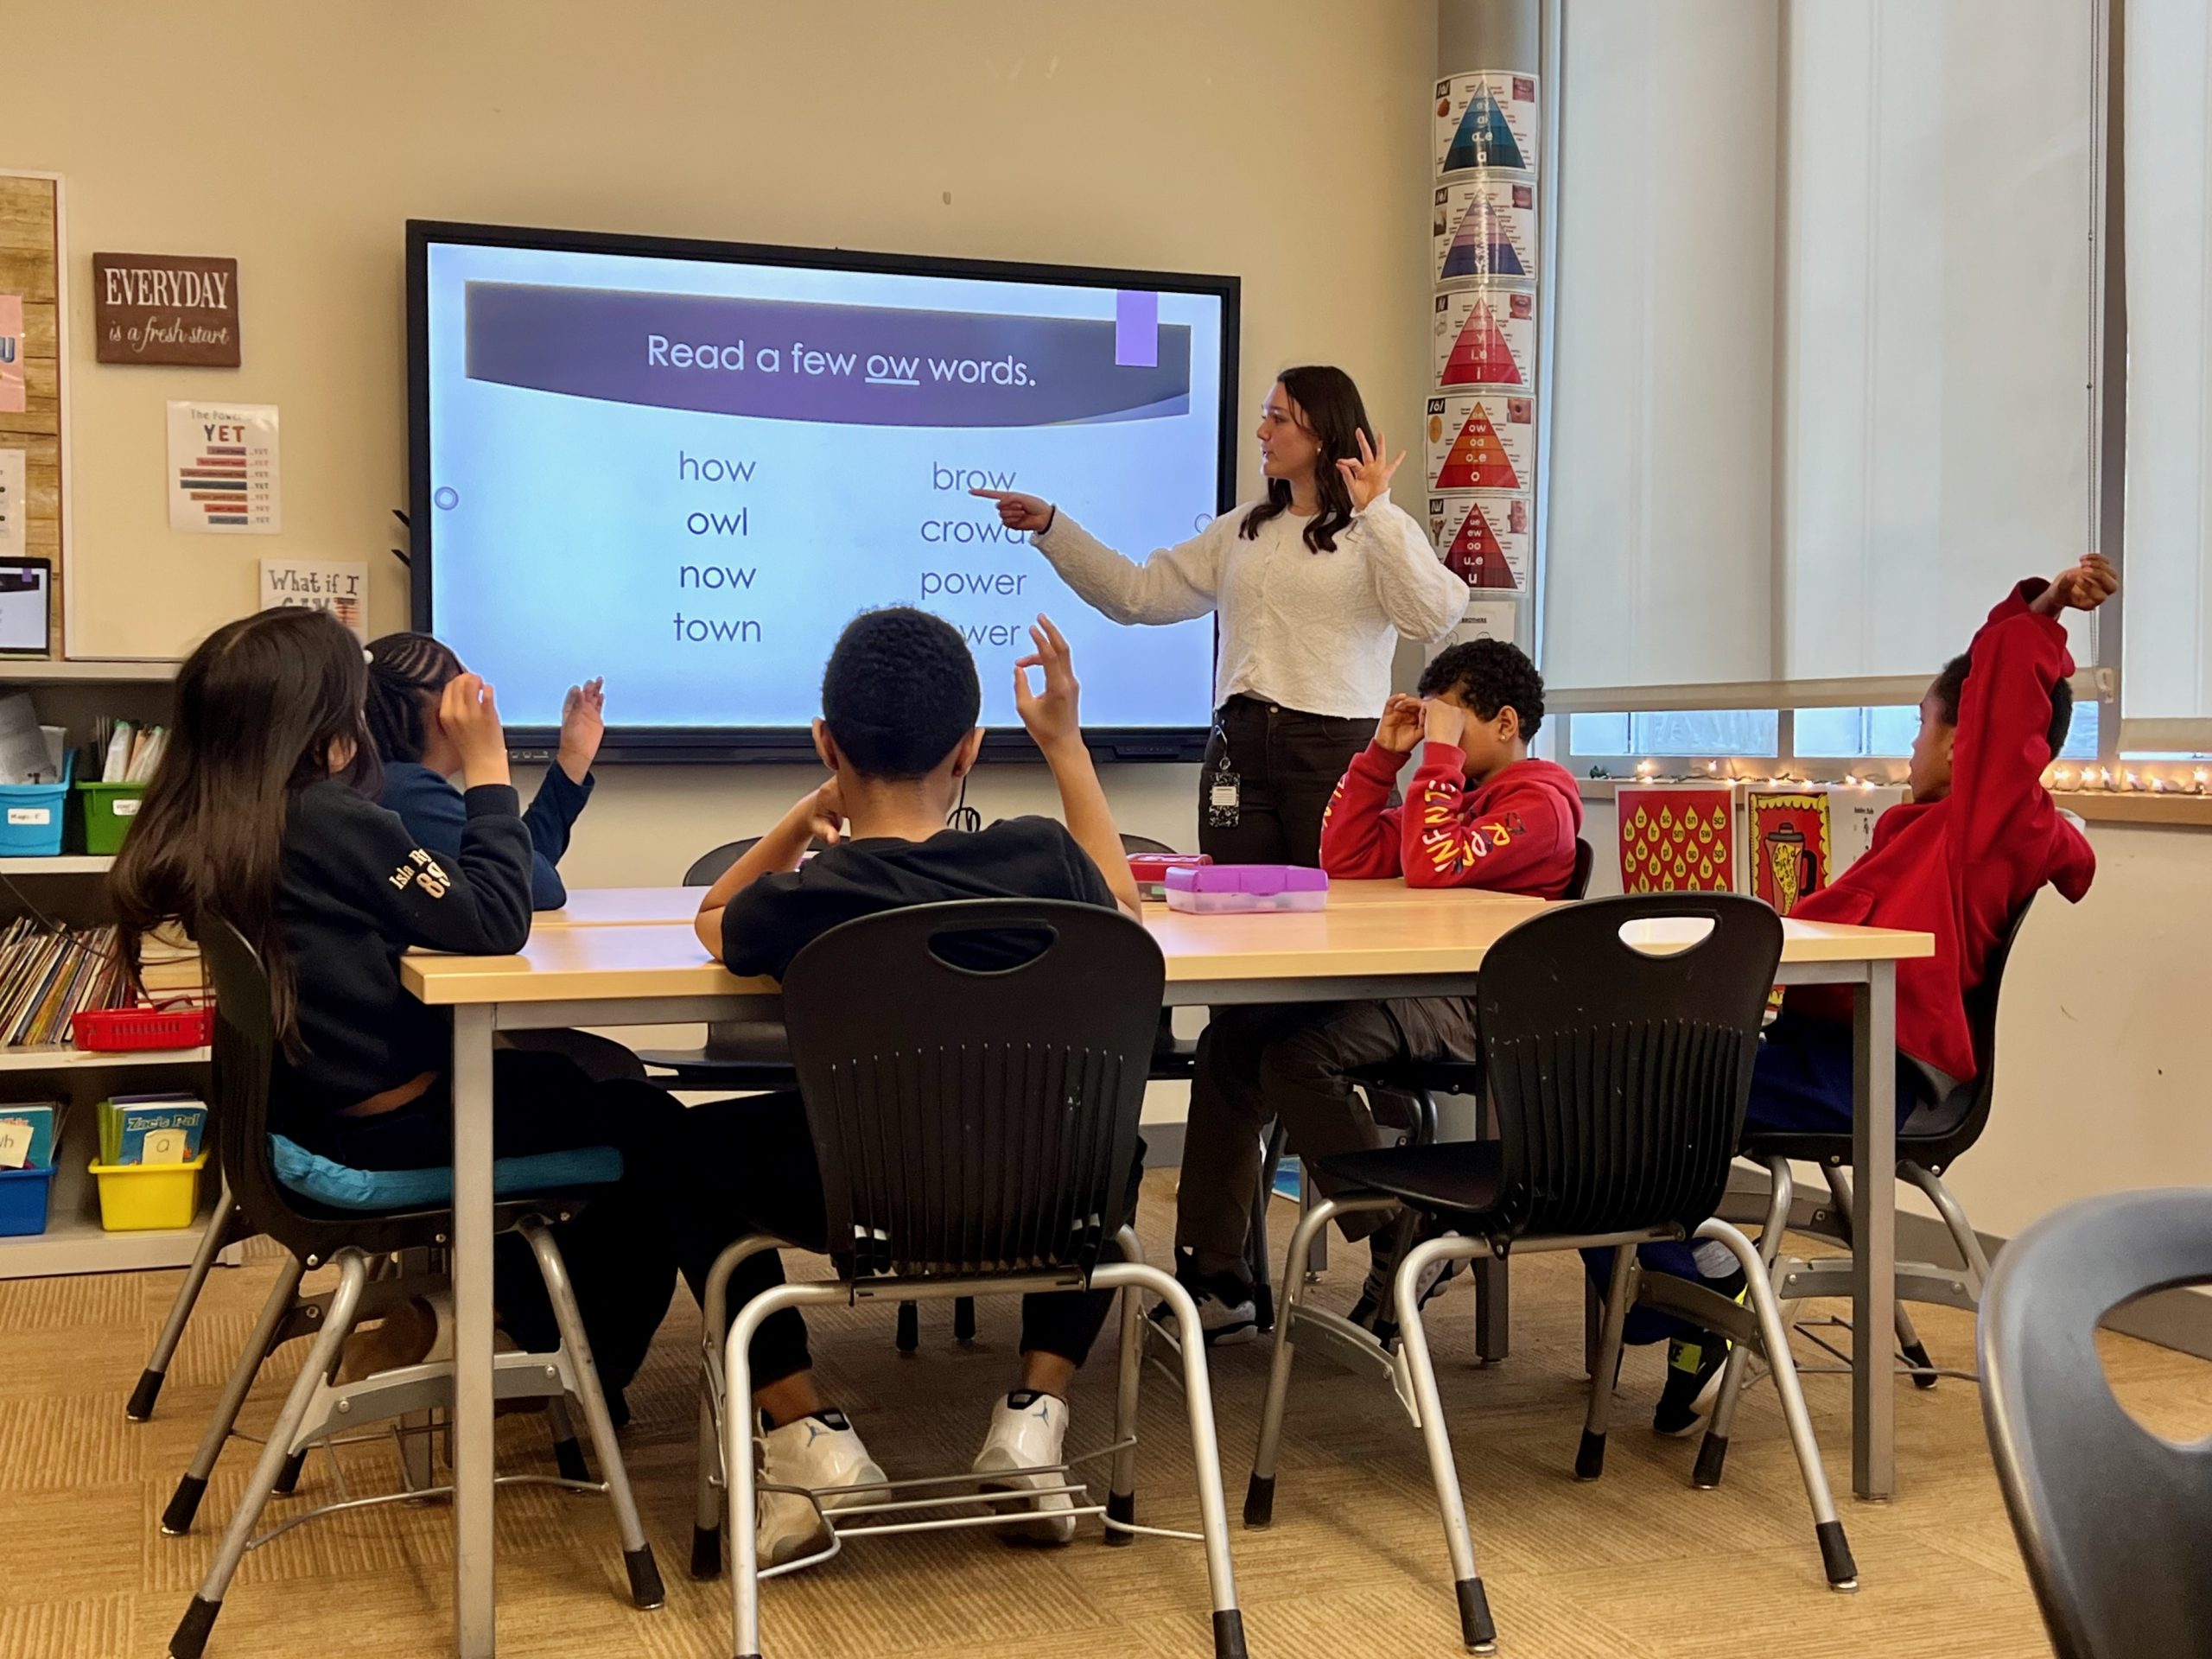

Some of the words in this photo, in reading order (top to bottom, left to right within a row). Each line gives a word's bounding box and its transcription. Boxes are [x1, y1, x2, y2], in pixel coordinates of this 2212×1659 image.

[104, 267, 229, 309] EVERYDAY
[109, 323, 122, 342] is
[127, 327, 140, 342] a
[131, 316, 186, 353] fresh
[188, 323, 229, 346] start
[647, 334, 745, 371] Read
[755, 348, 779, 372] a
[791, 342, 857, 377] few
[866, 353, 920, 385] ow
[928, 355, 1037, 387] words.
[204, 423, 245, 443] YET
[1469, 424, 1486, 433] ow
[1469, 438, 1484, 447] oa
[678, 450, 756, 481] how
[932, 461, 1017, 491] brow
[1471, 471, 1480, 482] o
[686, 506, 748, 537] owl
[1466, 542, 1482, 550] oo
[268, 569, 321, 594] What
[326, 574, 340, 594] if
[346, 575, 359, 596] I
[679, 564, 757, 589] now
[920, 570, 1027, 600] power
[1468, 574, 1478, 584] u
[673, 613, 761, 643] town
[388, 865, 416, 890] Isla
[173, 1113, 200, 1127] Pal
[156, 1139, 170, 1153] a
